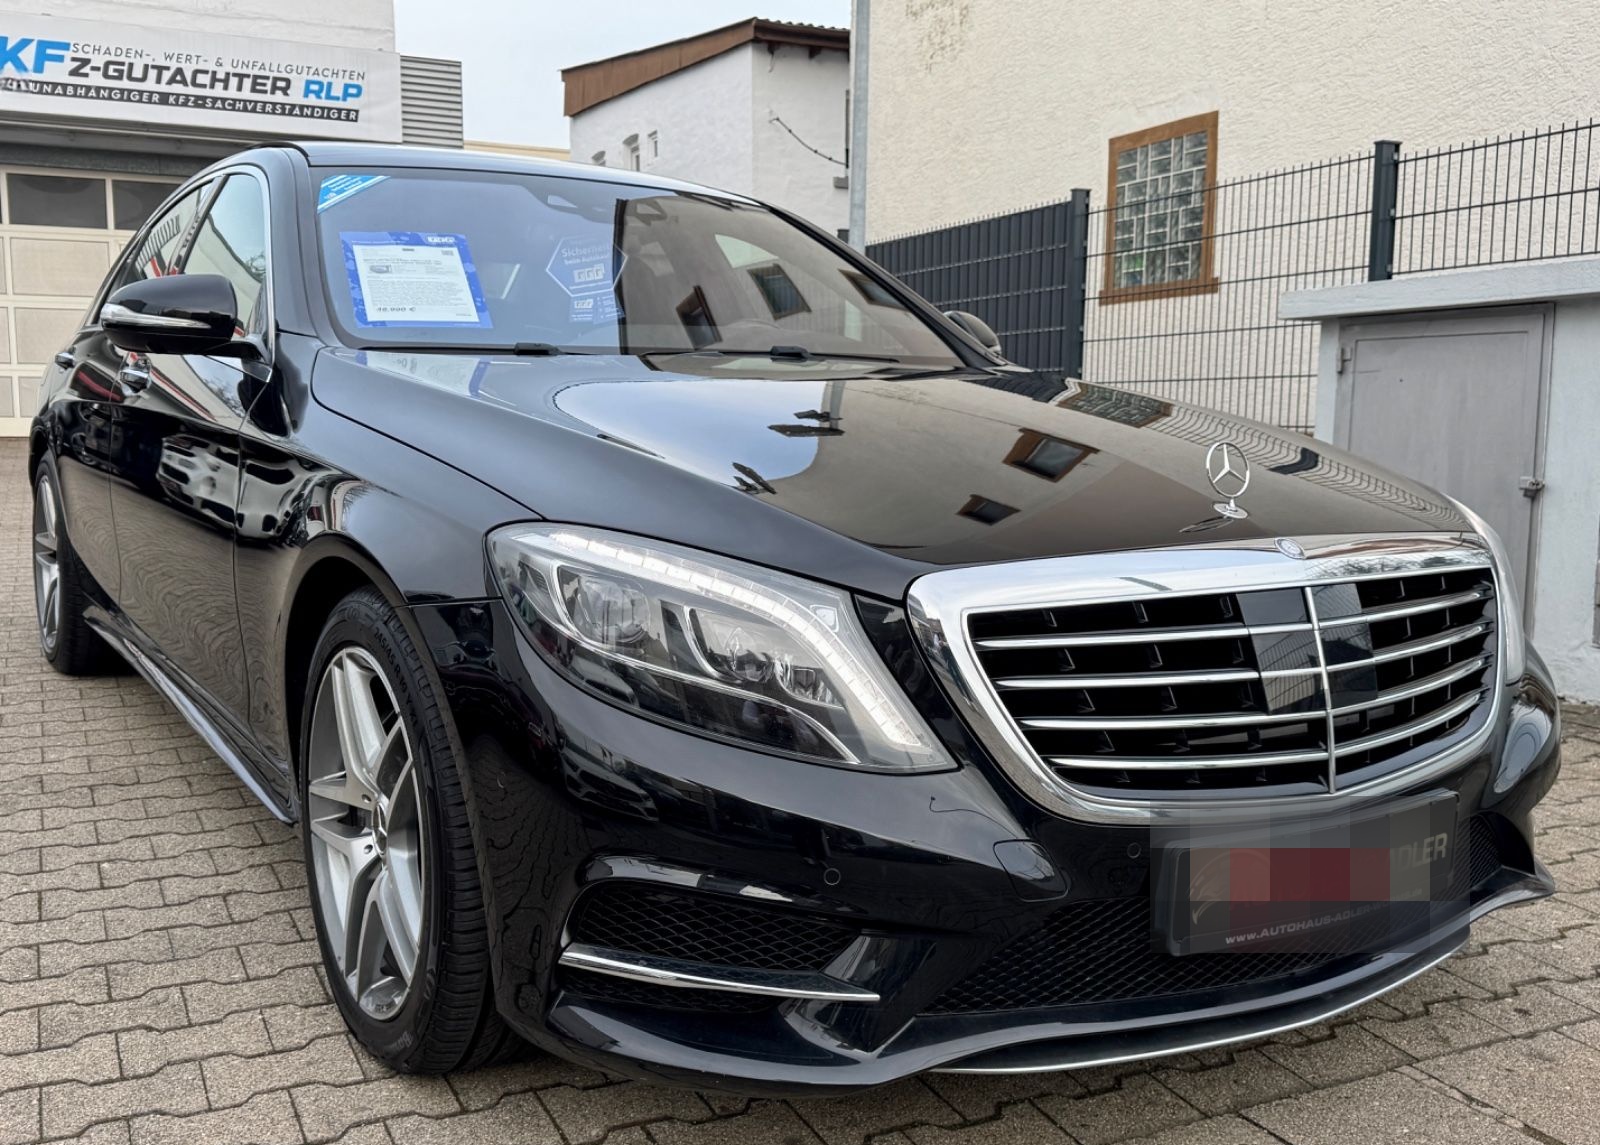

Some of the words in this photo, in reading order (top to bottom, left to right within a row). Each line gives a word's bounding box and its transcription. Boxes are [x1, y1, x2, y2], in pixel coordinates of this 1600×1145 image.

[68, 56, 292, 97] Z-GUTACHTER
[302, 79, 363, 102] RLP
[163, 51, 210, 66] WERT-
[215, 57, 224, 68] &
[231, 58, 366, 81] UNFALLGUTACHTEN
